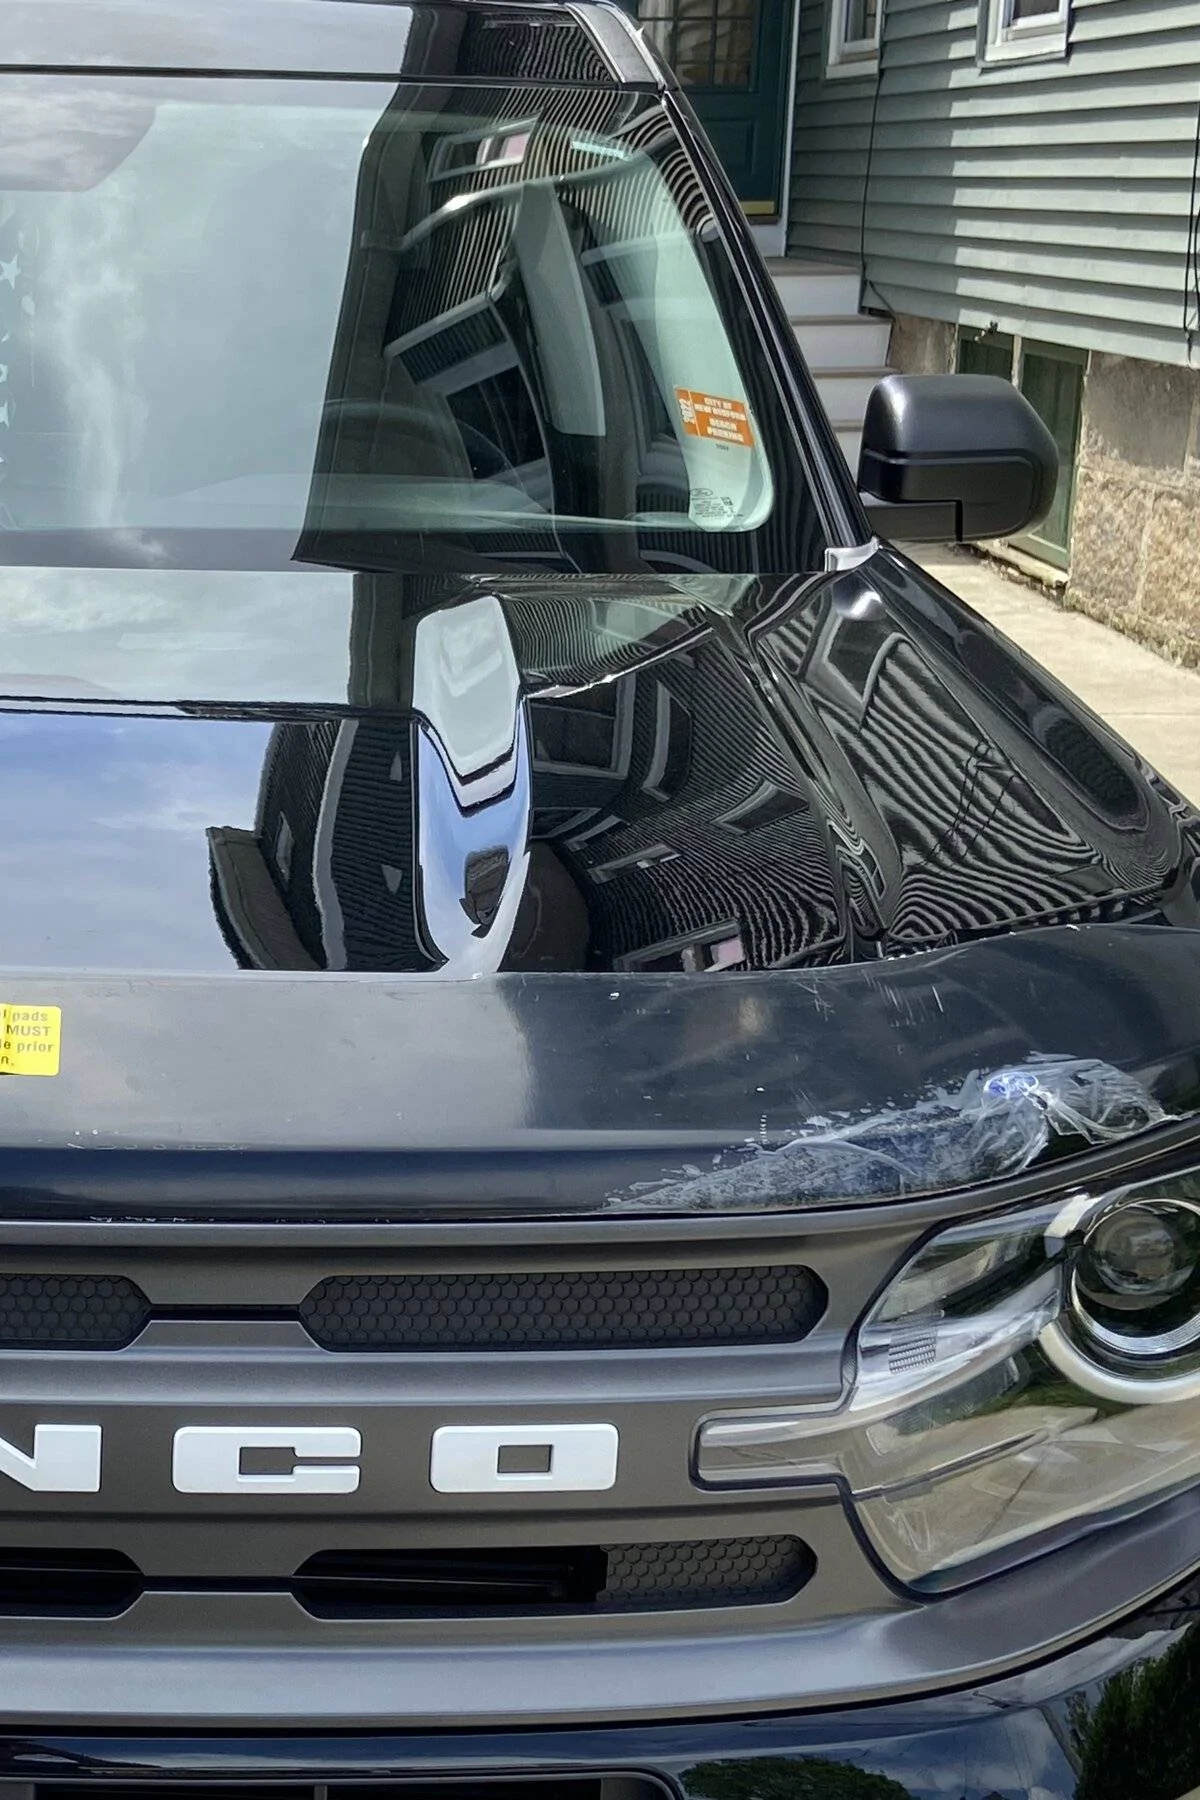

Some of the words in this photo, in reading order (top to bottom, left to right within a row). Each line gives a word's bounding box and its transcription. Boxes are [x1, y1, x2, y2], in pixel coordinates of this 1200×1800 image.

[12, 1011, 48, 1022] pads
[6, 1024, 51, 1037] MUST
[17, 1041, 54, 1053] prior
